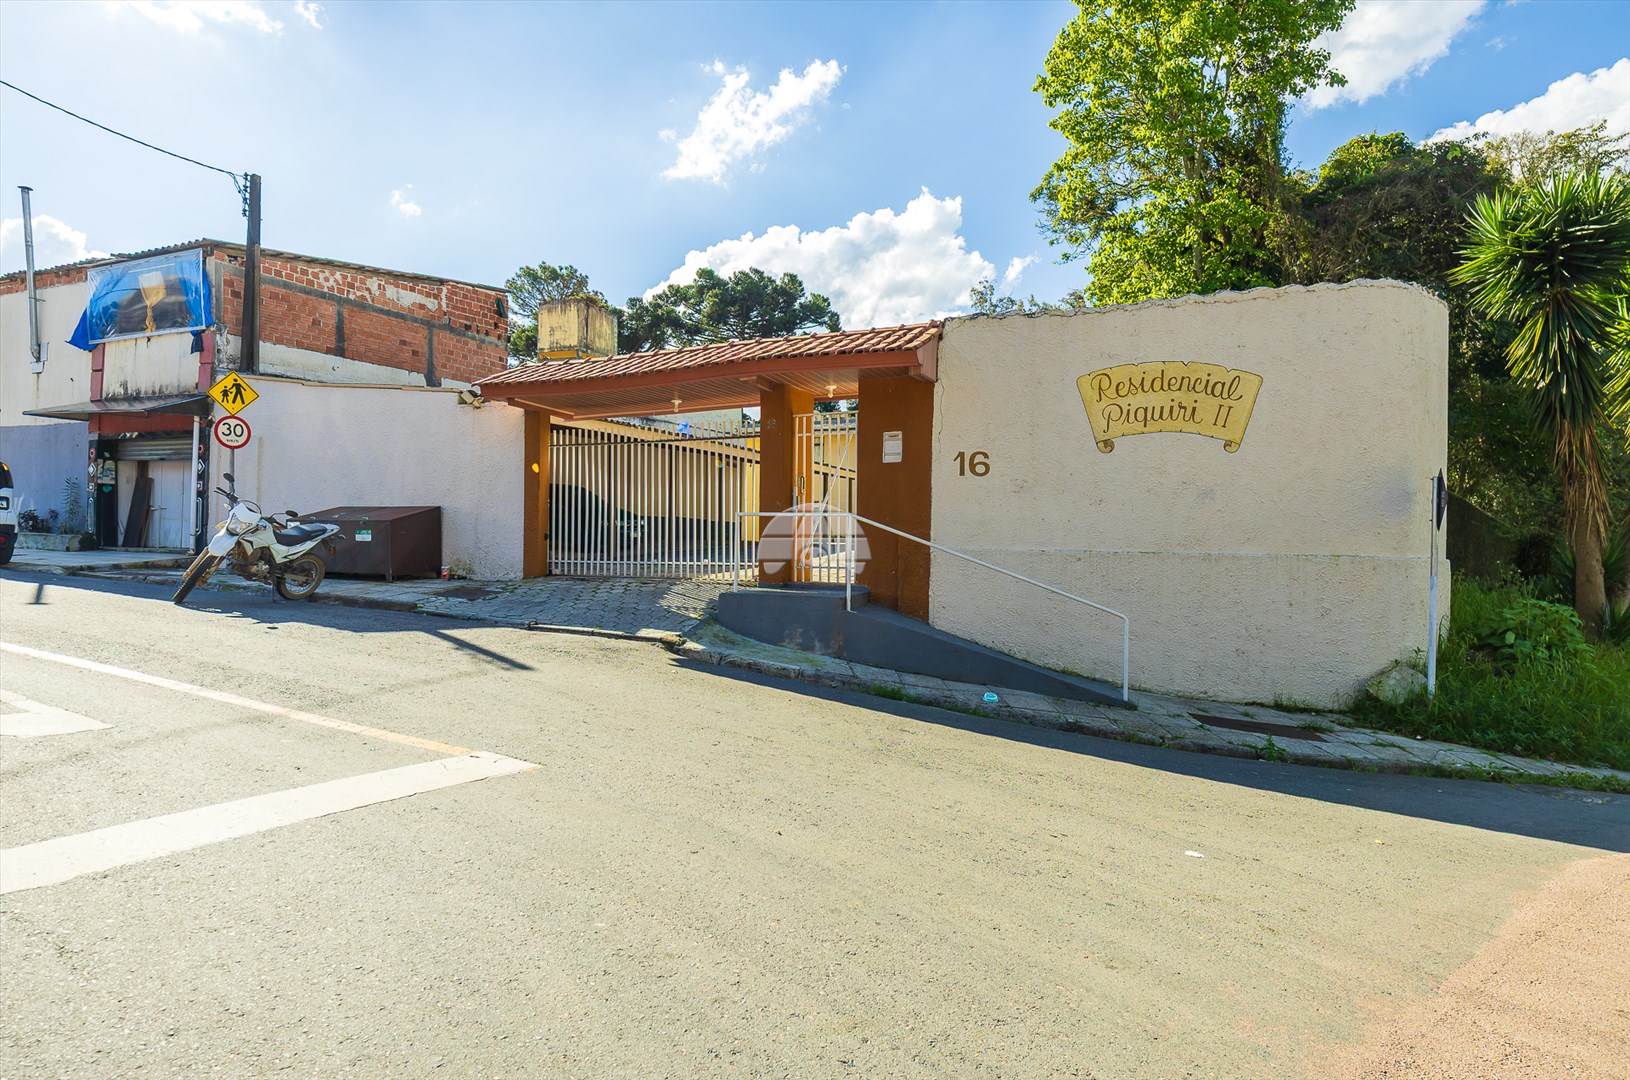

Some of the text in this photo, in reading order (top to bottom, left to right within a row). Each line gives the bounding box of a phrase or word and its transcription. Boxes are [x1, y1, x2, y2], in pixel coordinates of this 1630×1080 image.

[1090, 369, 1243, 402] Residencial
[221, 422, 244, 437] 30
[1101, 398, 1234, 433] Piquiri II
[953, 450, 990, 477] 16
